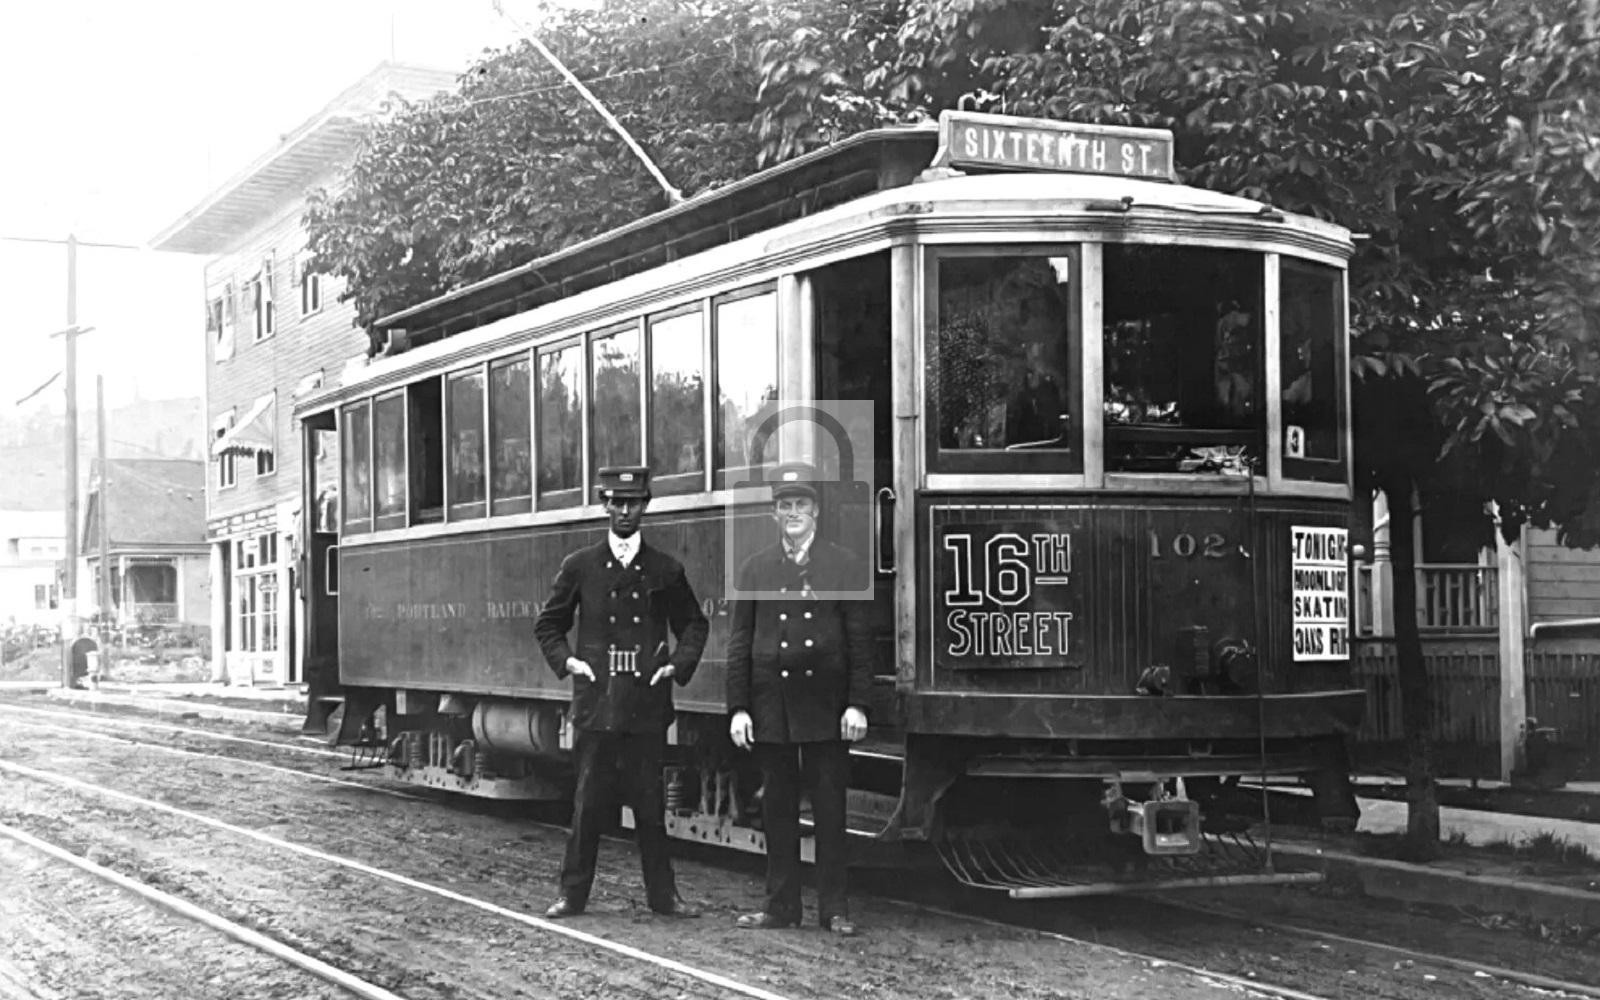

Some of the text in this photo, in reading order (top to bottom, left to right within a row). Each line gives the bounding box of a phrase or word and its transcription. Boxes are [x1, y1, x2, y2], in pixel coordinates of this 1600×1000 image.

[965, 127, 1105, 170] SIXTEENTH
[1147, 529, 1226, 557] 102
[947, 609, 1073, 656] STREET
